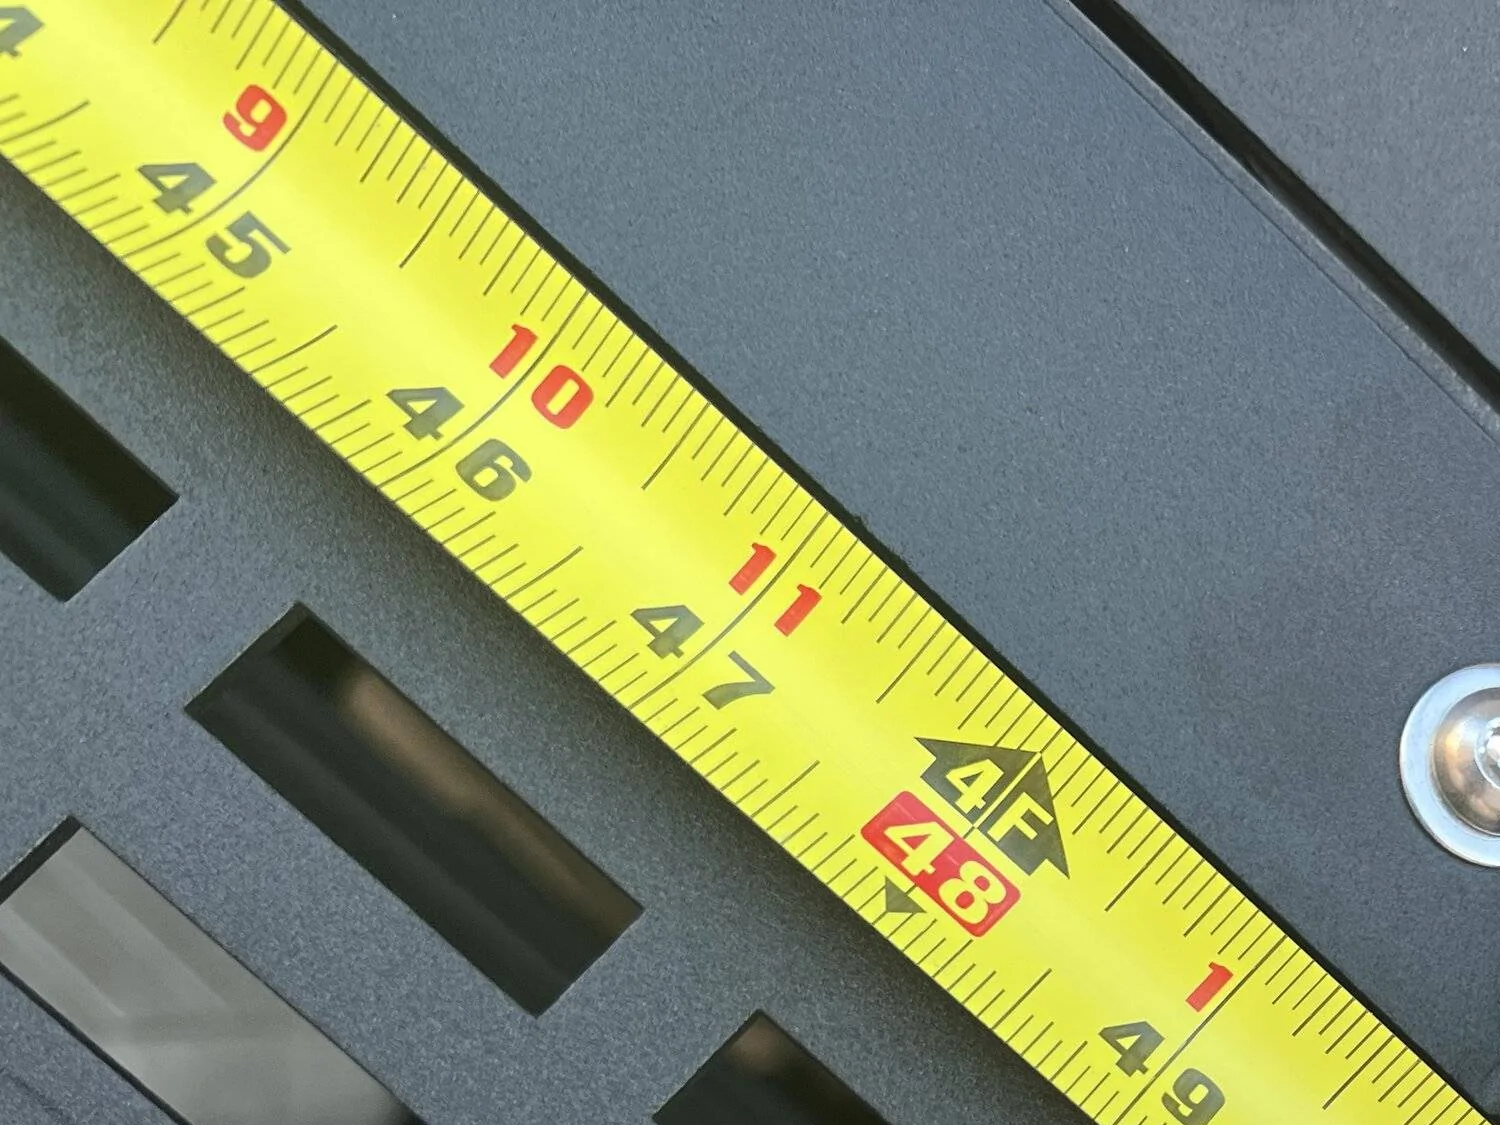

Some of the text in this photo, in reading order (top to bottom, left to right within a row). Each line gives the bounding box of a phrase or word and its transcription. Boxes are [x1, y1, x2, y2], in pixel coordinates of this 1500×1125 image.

[223, 84, 287, 152] 9
[136, 162, 290, 278] 45
[489, 323, 594, 429] 10
[386, 386, 532, 501] 46
[729, 543, 822, 636] 11
[630, 605, 775, 709] 47
[946, 759, 1053, 844] 4F
[883, 821, 1007, 925] 48
[1185, 961, 1233, 1012] 1
